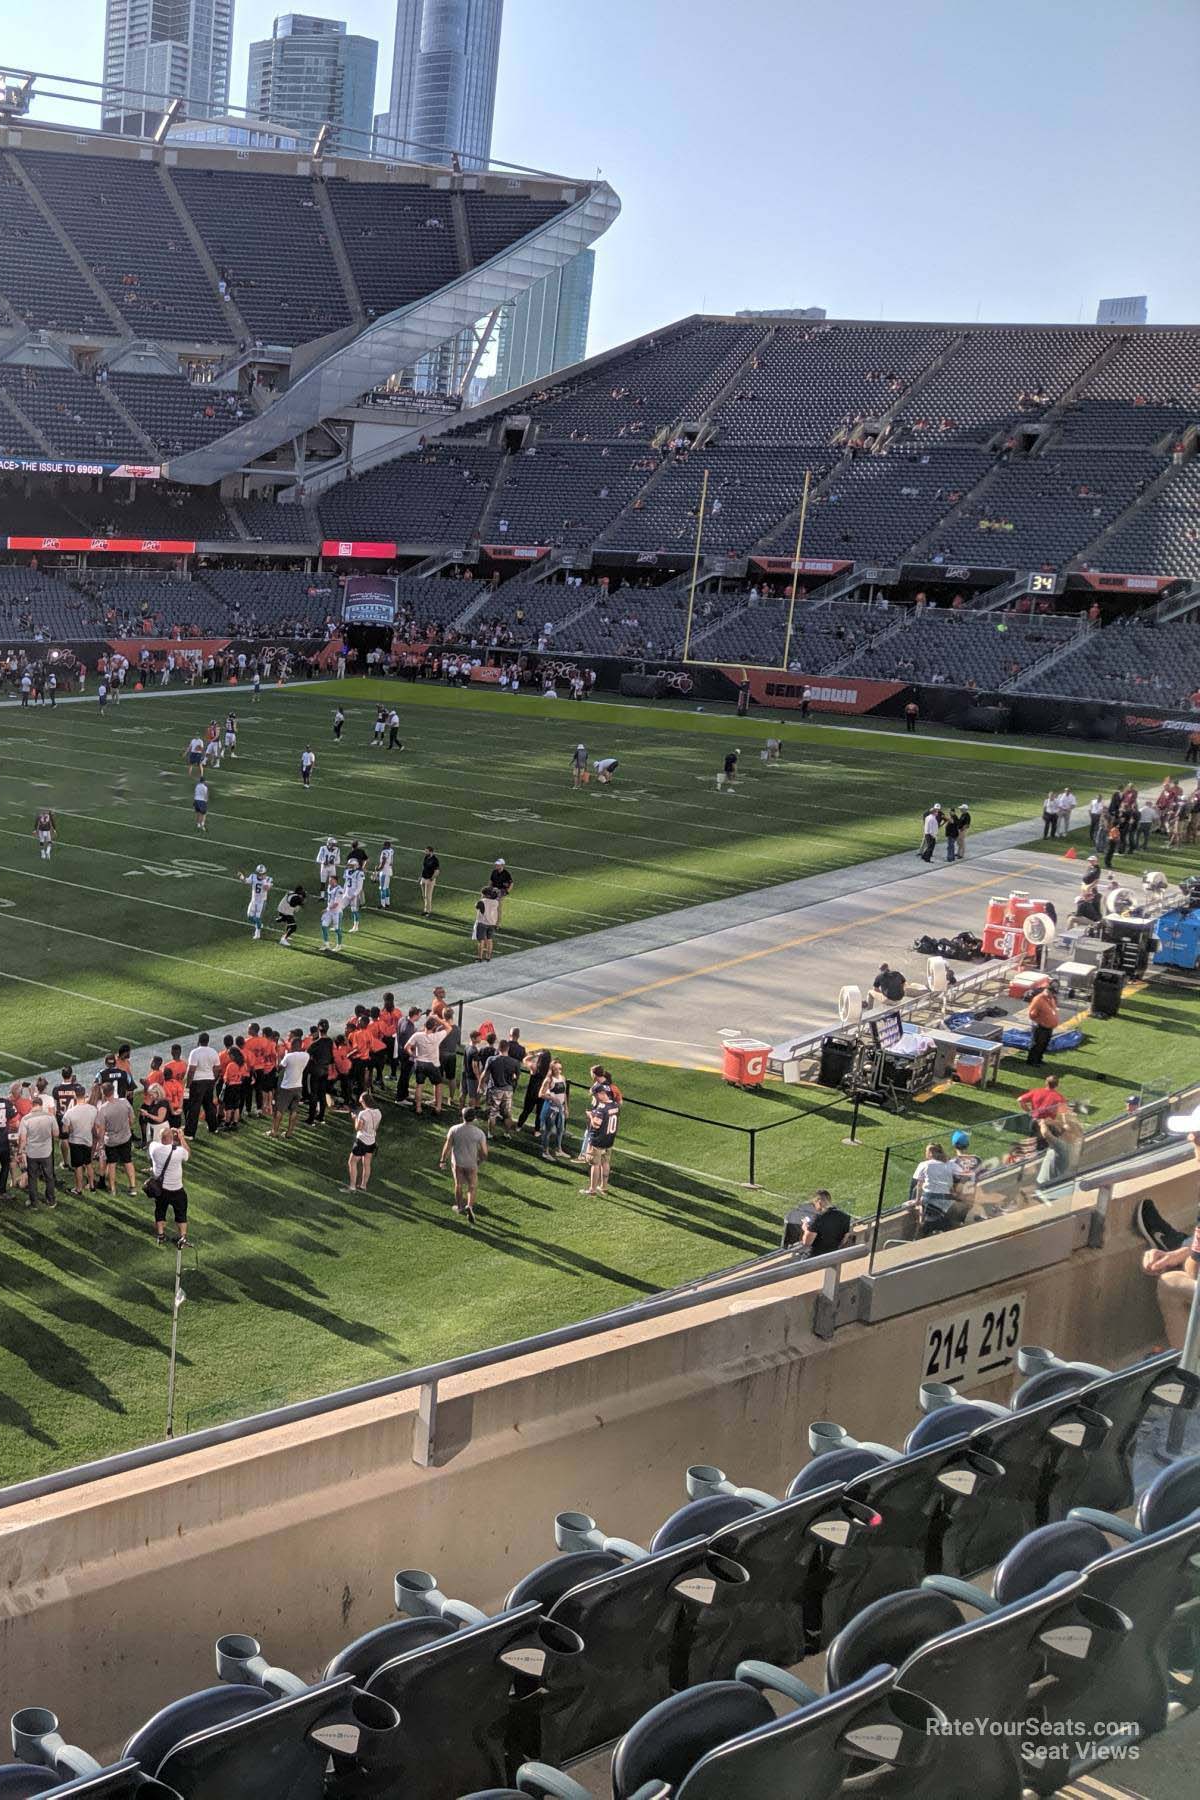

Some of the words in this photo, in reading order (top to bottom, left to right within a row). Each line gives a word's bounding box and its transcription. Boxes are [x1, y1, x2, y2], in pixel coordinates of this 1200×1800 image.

[21, 460, 37, 471] THE
[38, 461, 62, 472] ISSUE
[63, 462, 76, 473] TO
[77, 463, 103, 474] 69050
[1032, 576, 1052, 590] 34
[255, 883, 262, 895] 6
[747, 1056, 763, 1076] G
[112, 1079, 119, 1099] 1
[60, 1098, 76, 1115] 54
[607, 1115, 618, 1135] 10
[926, 1319, 969, 1376] 214
[978, 1303, 1021, 1357] 213
